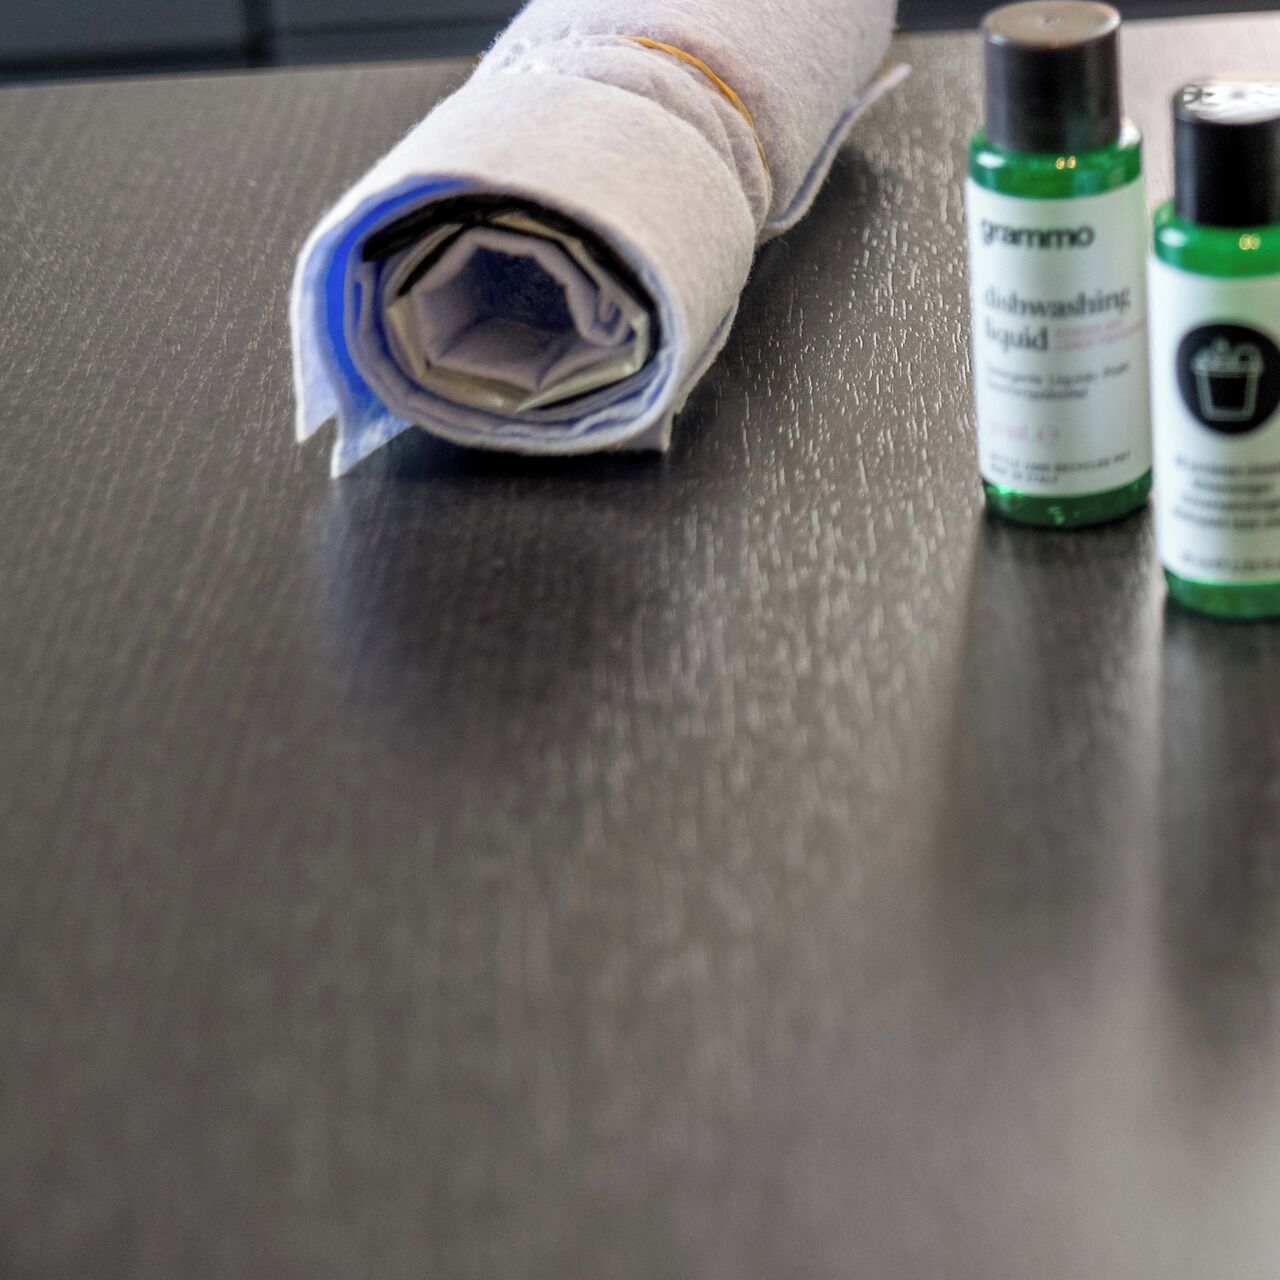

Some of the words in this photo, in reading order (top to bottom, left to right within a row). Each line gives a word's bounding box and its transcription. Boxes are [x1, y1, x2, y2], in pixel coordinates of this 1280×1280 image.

[981, 218, 1096, 249] grammo
[985, 286, 1131, 320] dishwashing
[986, 317, 1049, 354] liquid
